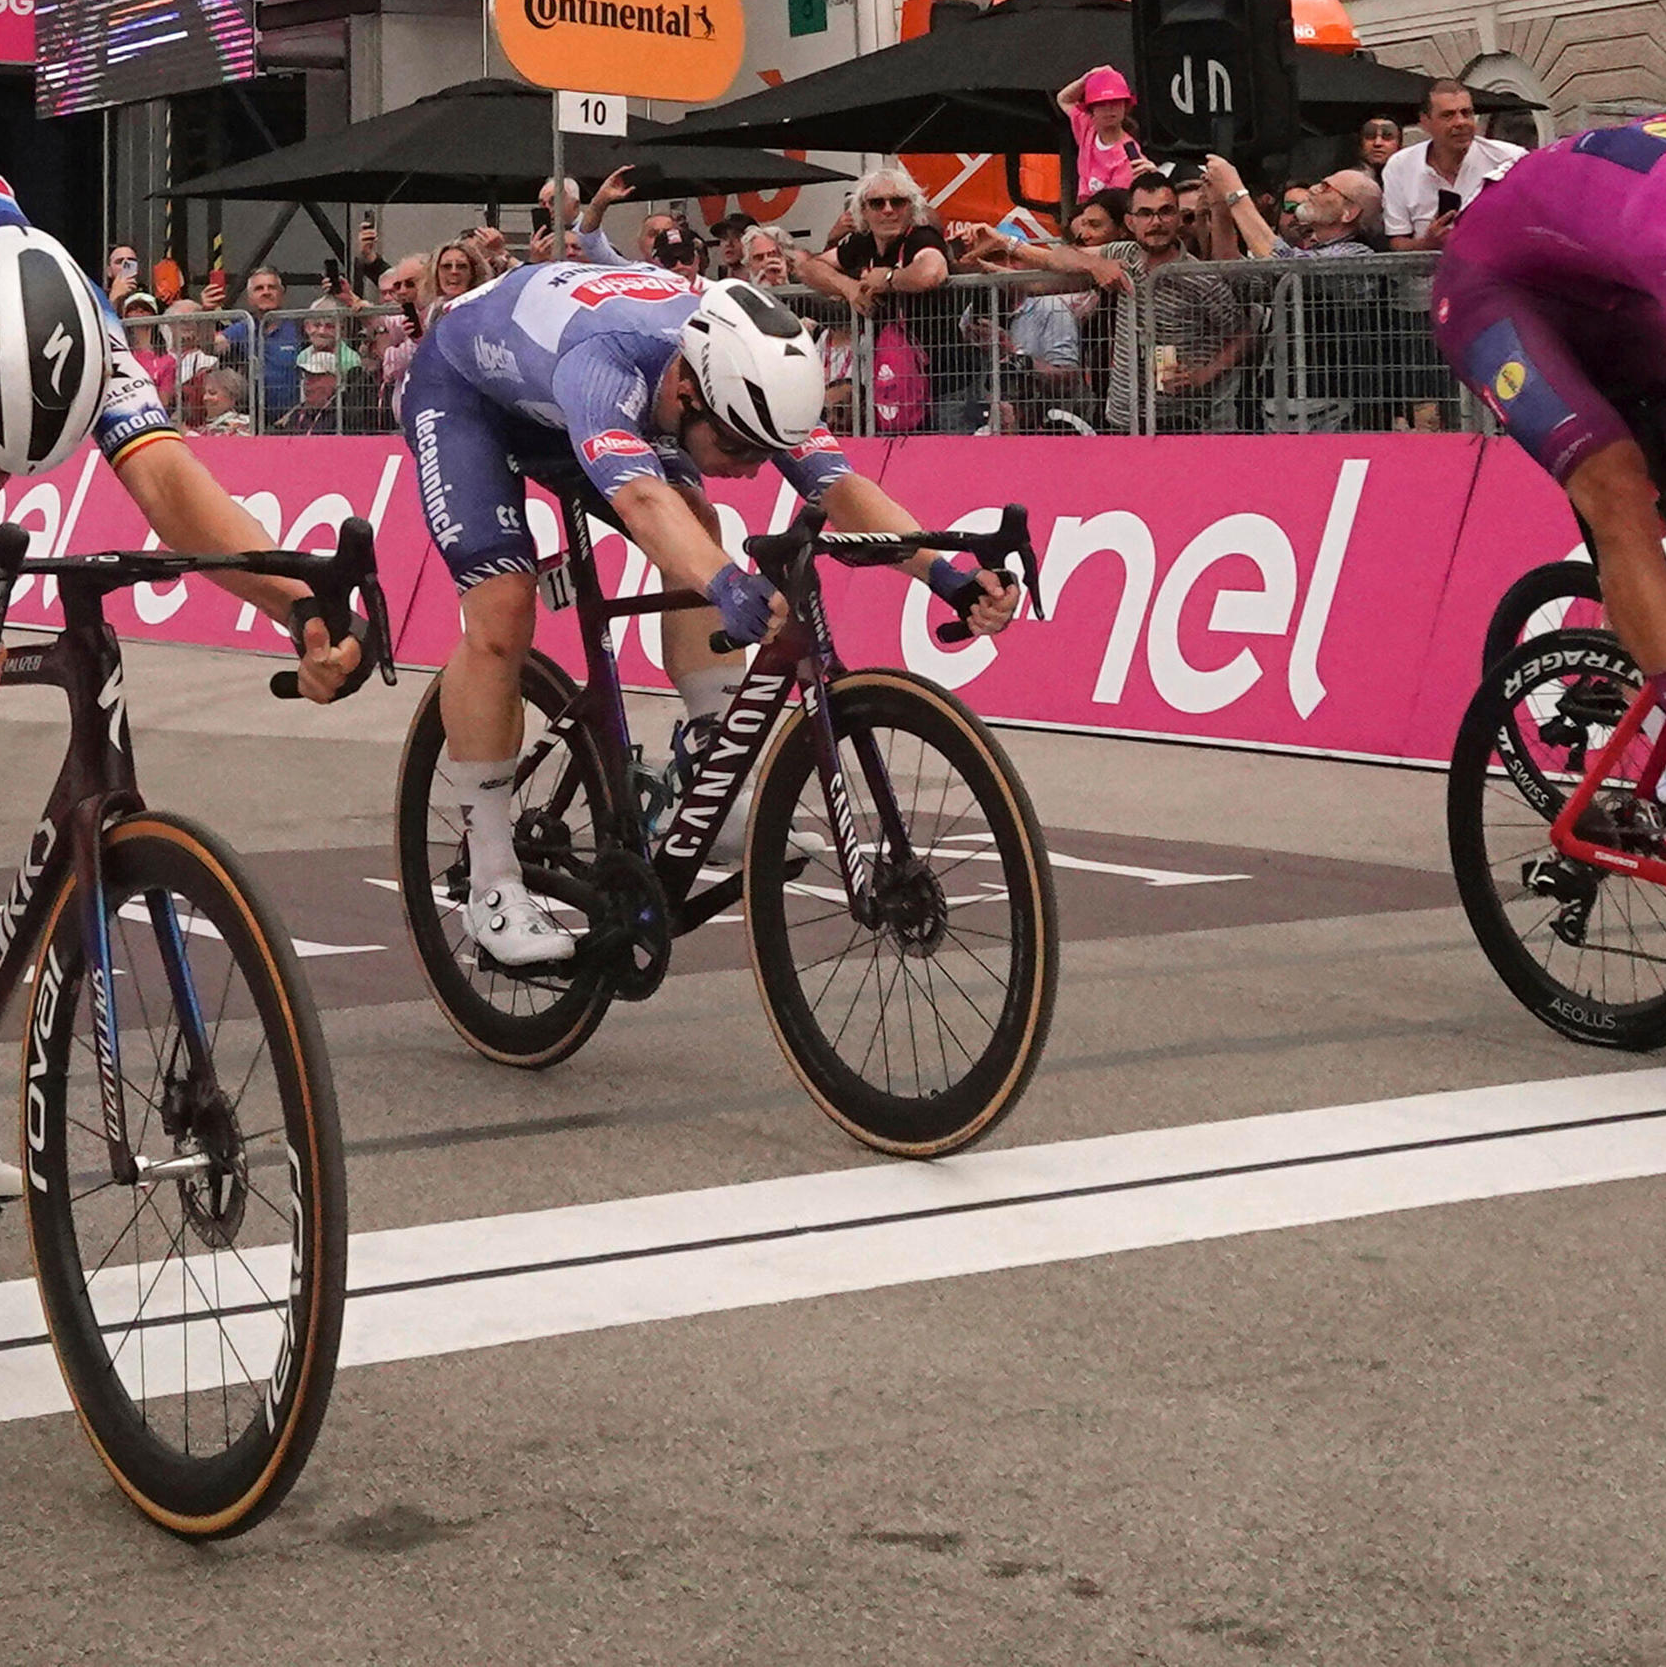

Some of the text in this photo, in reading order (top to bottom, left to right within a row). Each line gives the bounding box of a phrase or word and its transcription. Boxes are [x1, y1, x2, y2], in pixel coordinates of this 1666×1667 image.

[578, 97, 608, 127] 10
[415, 407, 464, 551] deceuninck
[664, 674, 787, 859] CANYON
[1508, 758, 1550, 809] SWISS
[829, 770, 866, 896] CANYON
[27, 943, 65, 1194] roval
[1546, 995, 1618, 1031] AEOLUS
